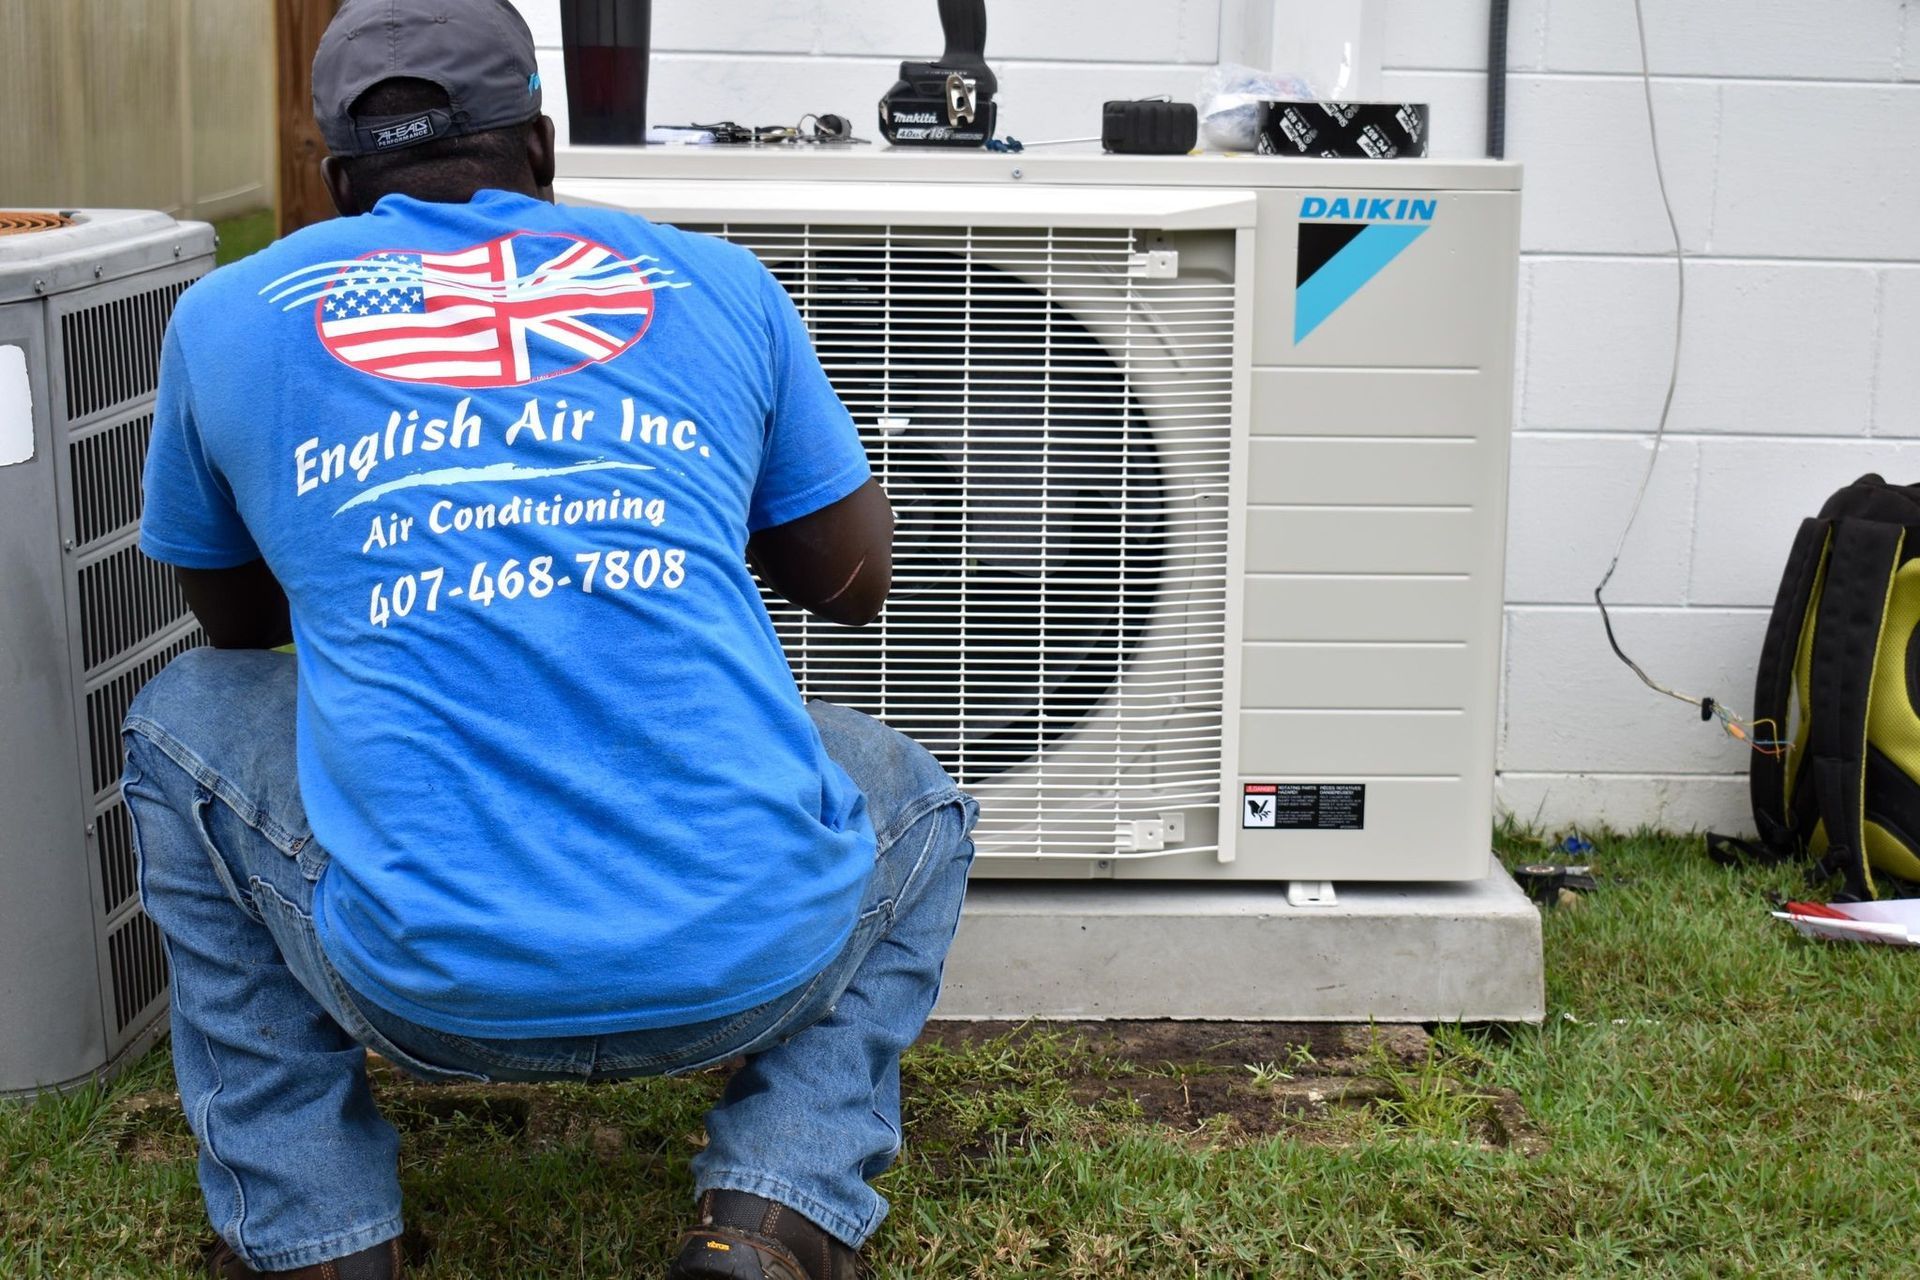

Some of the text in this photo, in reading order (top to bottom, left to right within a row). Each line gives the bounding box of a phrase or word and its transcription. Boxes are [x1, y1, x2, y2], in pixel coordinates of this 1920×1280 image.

[378, 129, 428, 147] PERFORMANCE
[1299, 197, 1437, 220] DAIKIN
[295, 397, 711, 496] English Air Inc.
[362, 489, 666, 553] Air Conditioning
[369, 548, 686, 628] 407-468-7808
